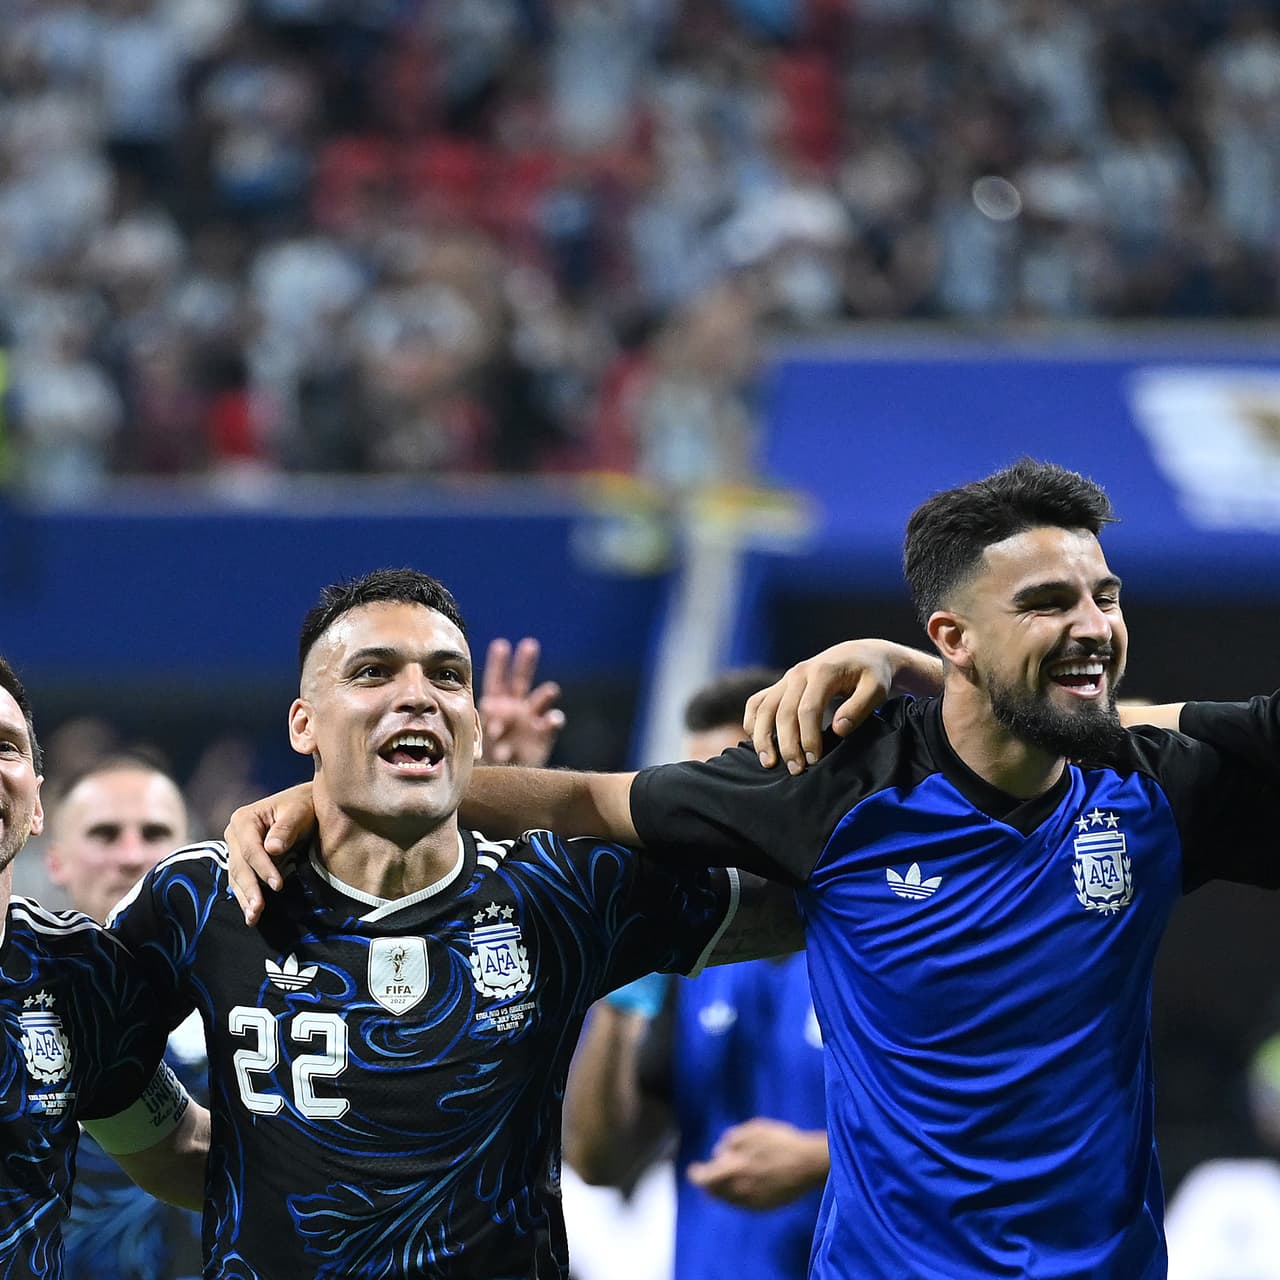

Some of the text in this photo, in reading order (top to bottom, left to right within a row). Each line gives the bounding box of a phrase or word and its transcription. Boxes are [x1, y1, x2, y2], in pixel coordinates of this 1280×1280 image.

[1089, 855, 1120, 890] AFA
[484, 943, 518, 977] AFA
[386, 985, 412, 995] FIFA
[501, 1007, 508, 1015] VS
[35, 1029, 62, 1061] AFA
[228, 1005, 351, 1120] 22
